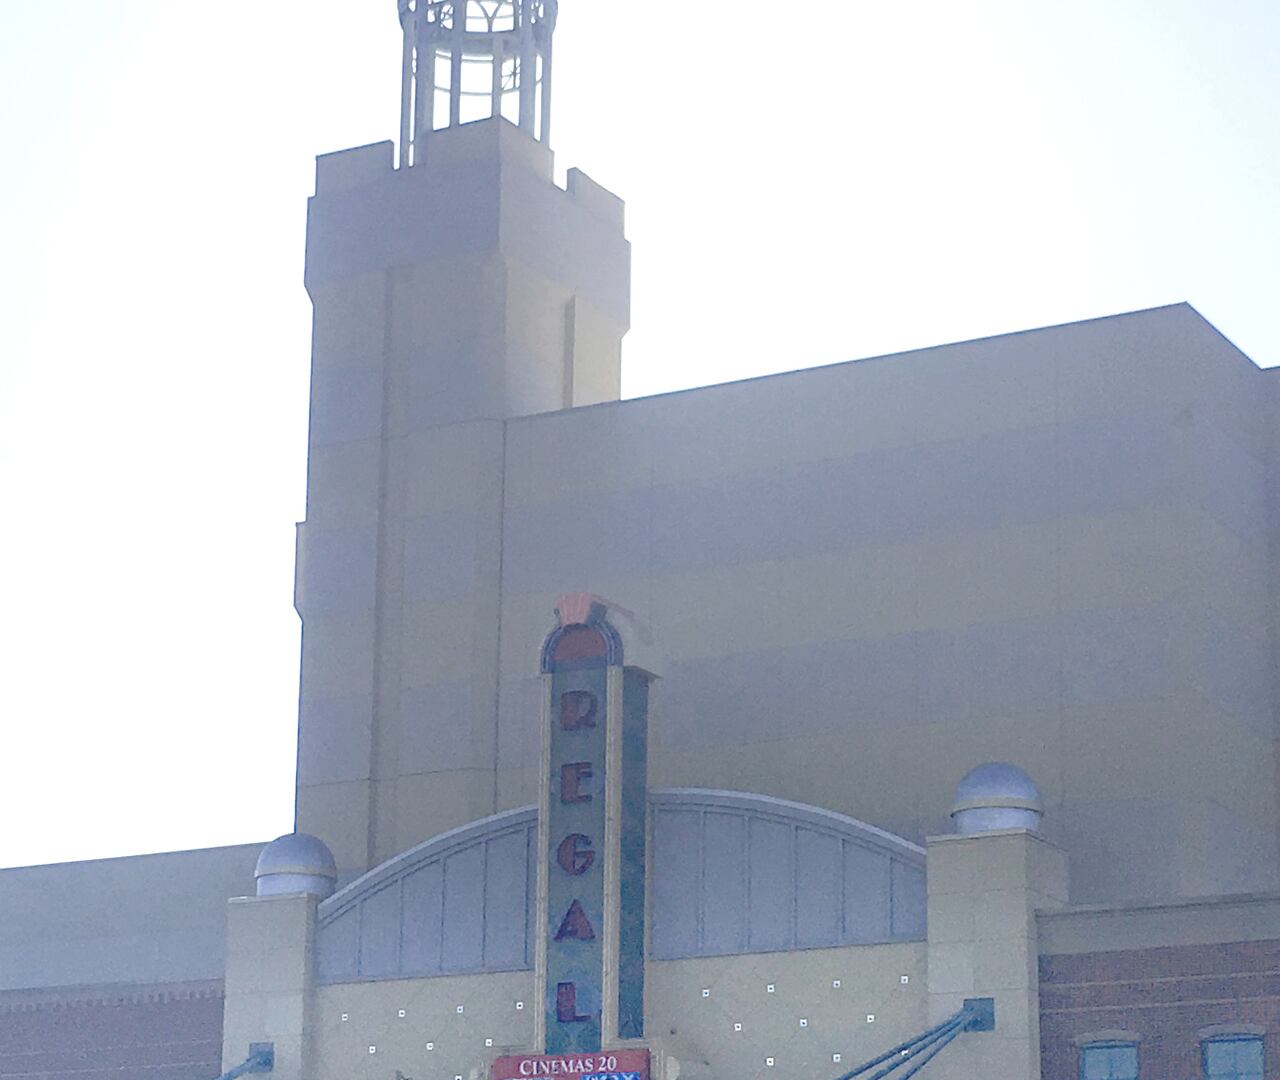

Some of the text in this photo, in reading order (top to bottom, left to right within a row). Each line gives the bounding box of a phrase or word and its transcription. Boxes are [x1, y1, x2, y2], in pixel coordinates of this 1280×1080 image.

[554, 690, 598, 1023] REGAL
[520, 1056, 617, 1075] CINEMAS 20
